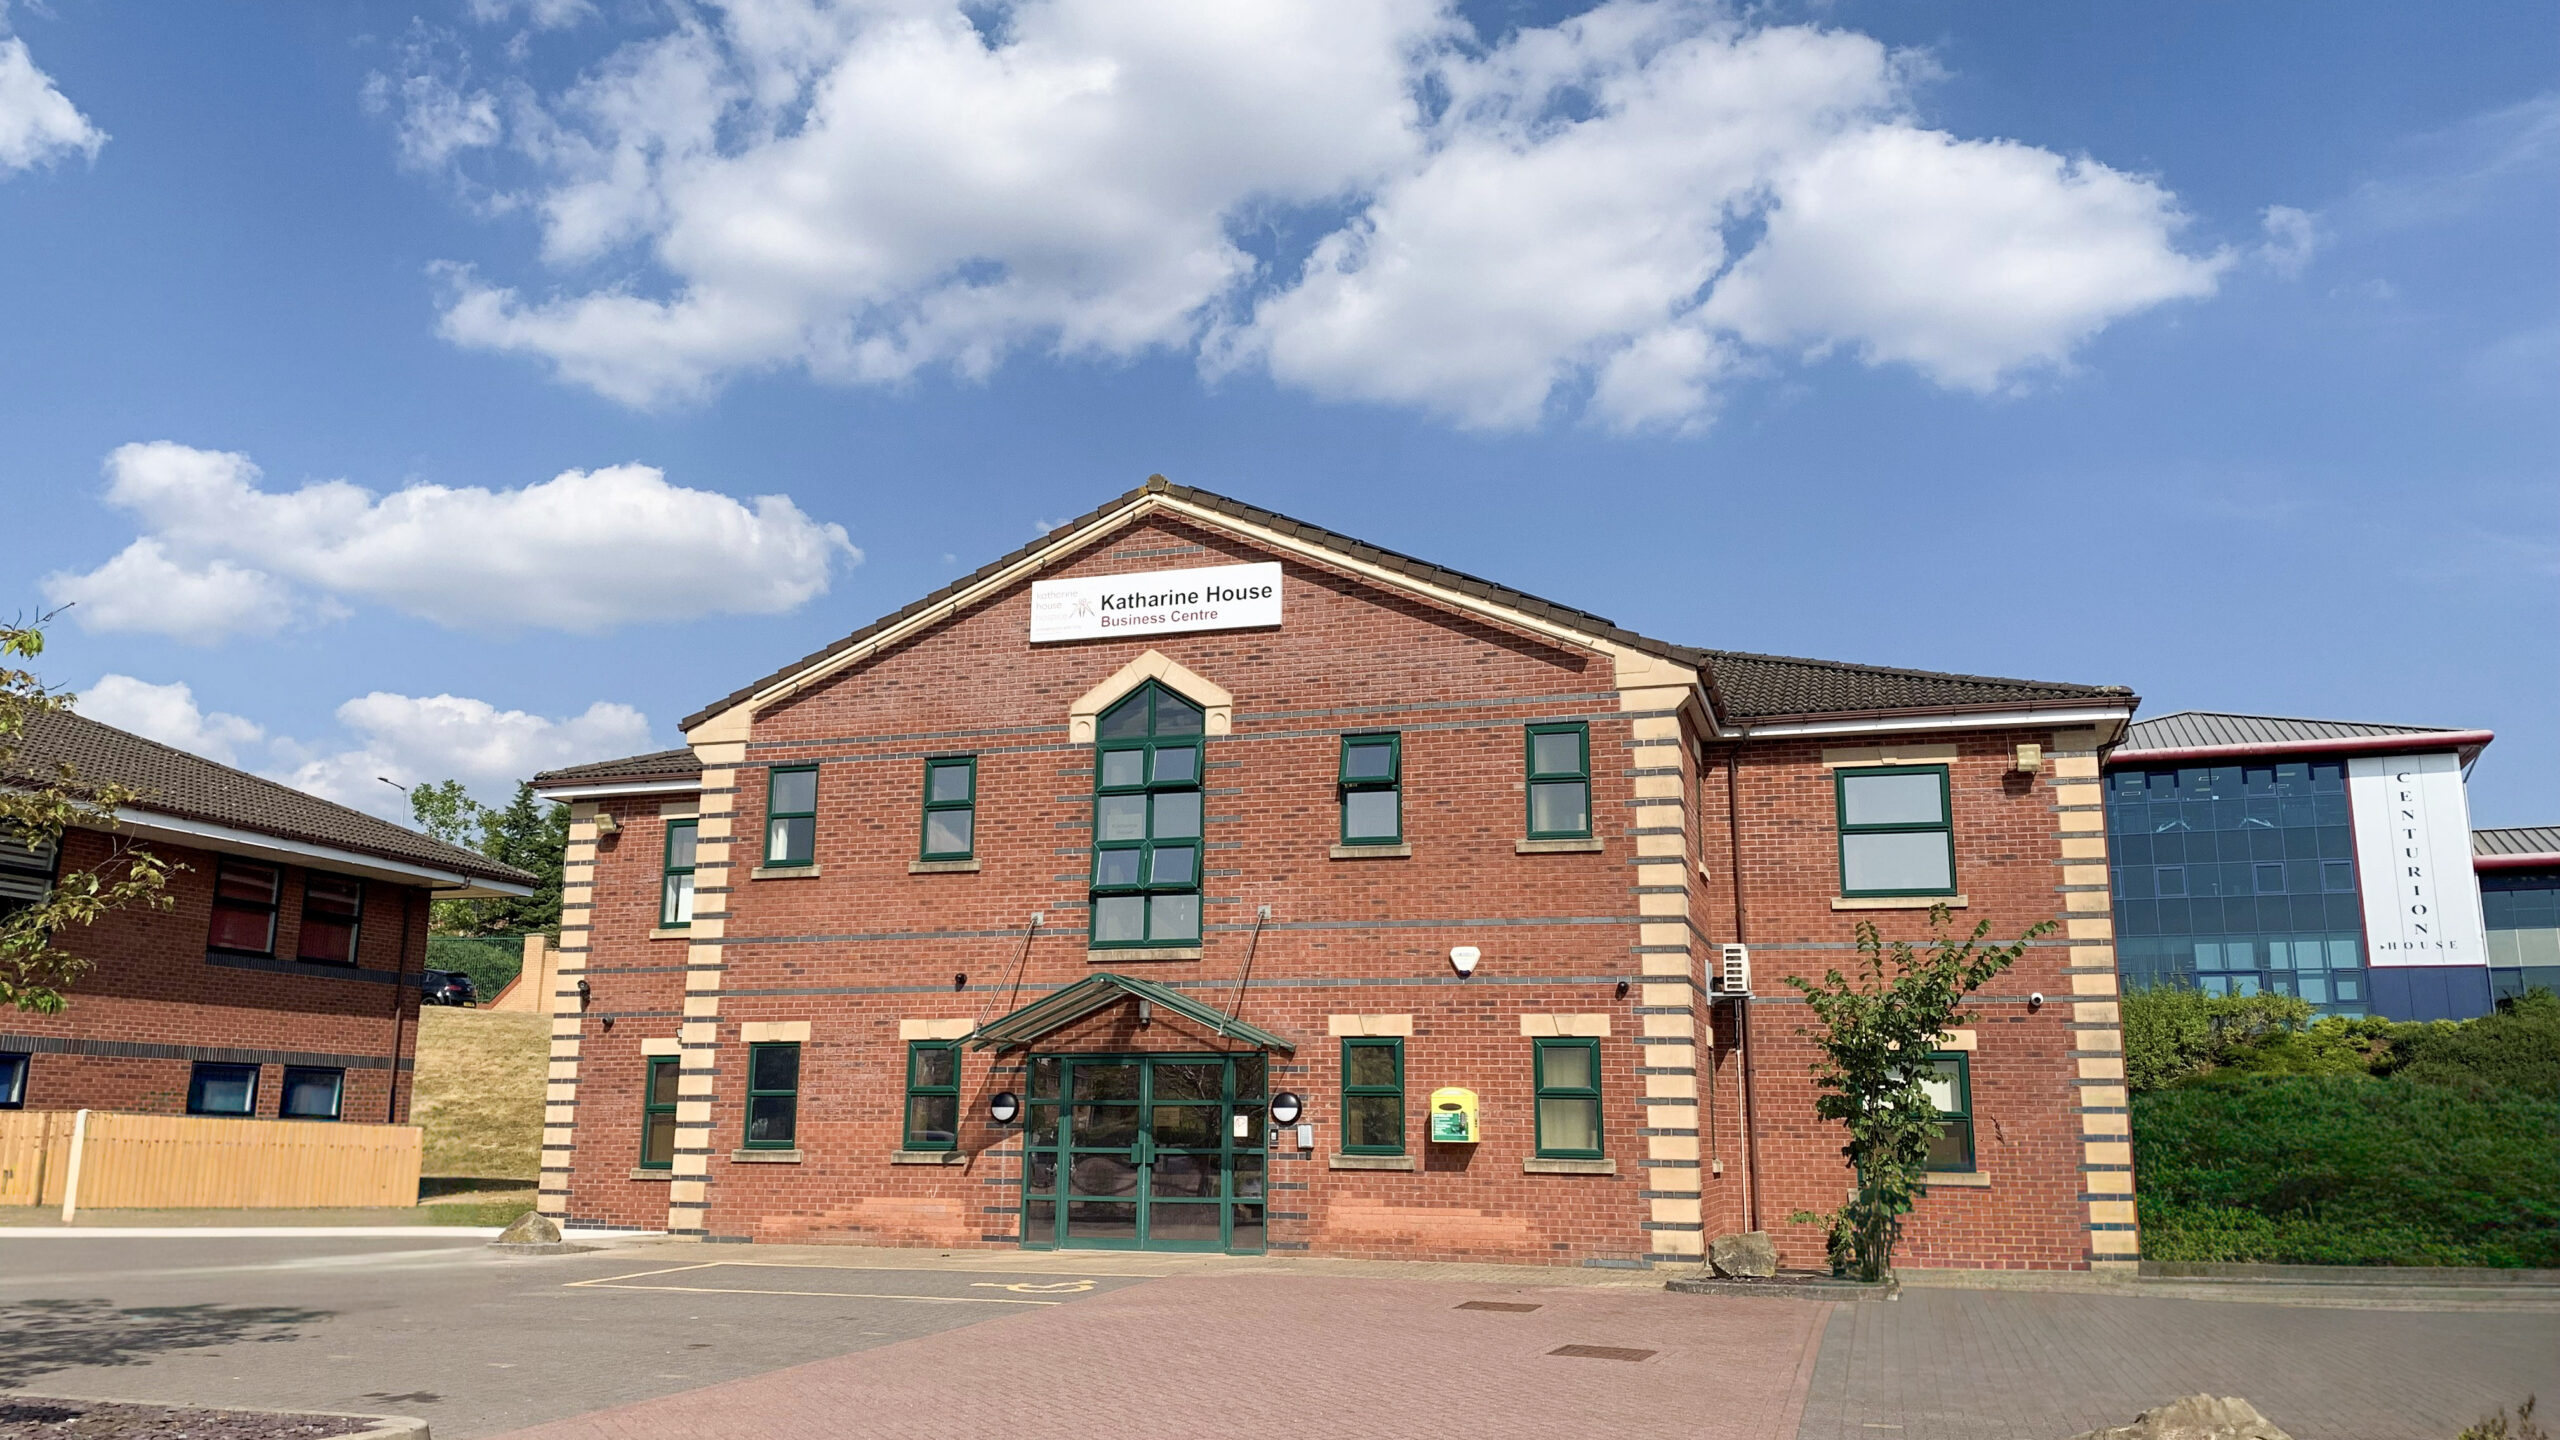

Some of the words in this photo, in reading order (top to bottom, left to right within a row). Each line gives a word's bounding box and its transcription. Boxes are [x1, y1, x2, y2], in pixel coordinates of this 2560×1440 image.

[1101, 589, 1199, 611] Katharine
[1206, 585, 1273, 603] House
[1101, 614, 1166, 628] Business
[1170, 610, 1218, 623] Centre
[2396, 771, 2429, 935] CENTURION
[2387, 940, 2458, 951] HOUSE
